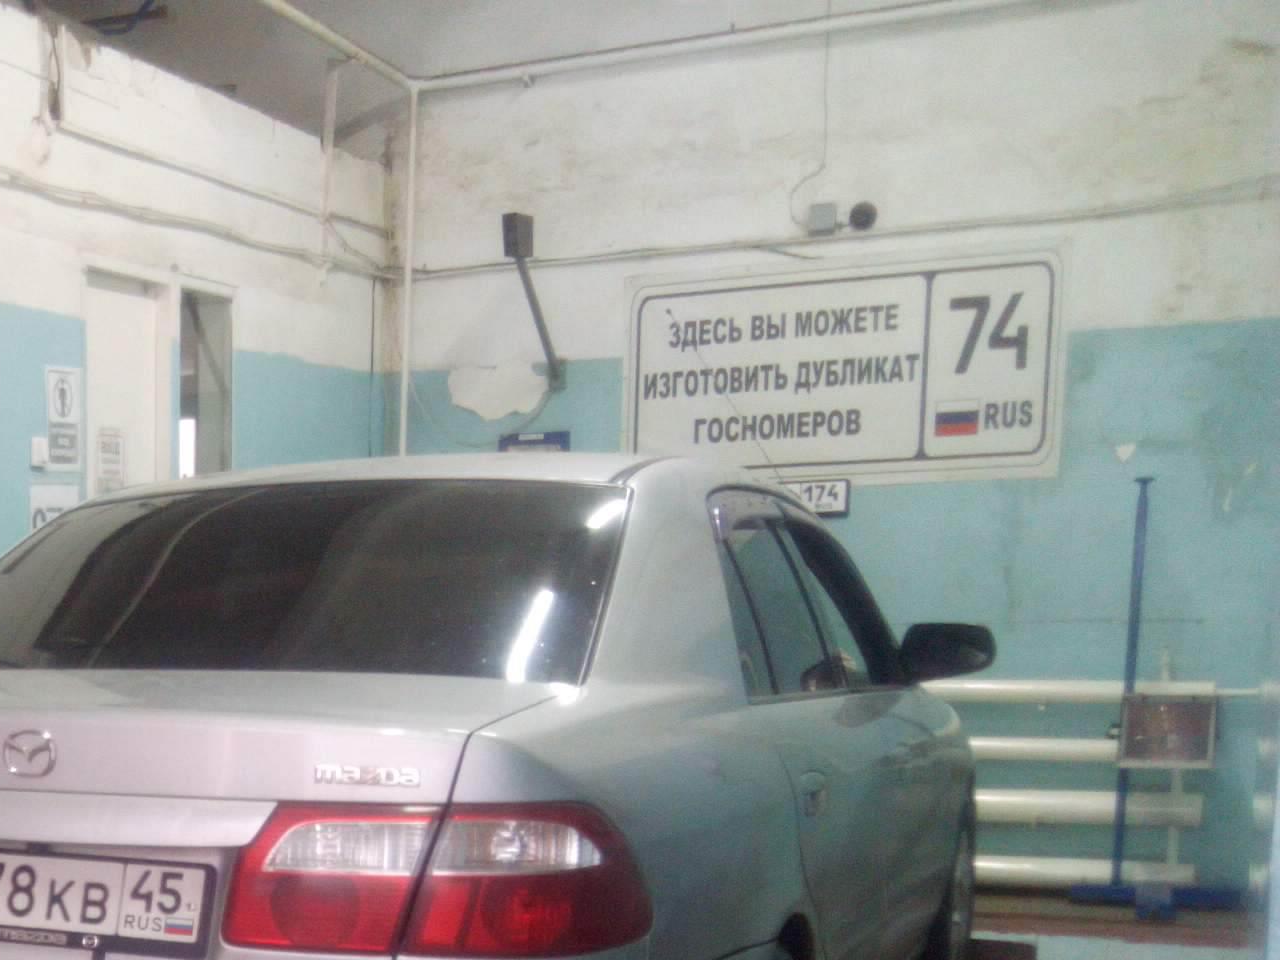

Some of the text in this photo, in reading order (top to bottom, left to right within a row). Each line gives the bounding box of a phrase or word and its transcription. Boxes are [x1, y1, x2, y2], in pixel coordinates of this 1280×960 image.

[668, 304, 900, 352] ЗДЕСЬ ВЫ МОЖЕТЕ
[949, 293, 1028, 374] 74
[643, 353, 920, 400] ИЗГОТОВИТЬ ДУБЛИКАТ
[693, 408, 862, 444] ГОСНОМЕРОВ
[984, 401, 1033, 430] RUS
[804, 484, 839, 502] 174
[130, 870, 183, 915] 45
[123, 914, 163, 932] RUS
